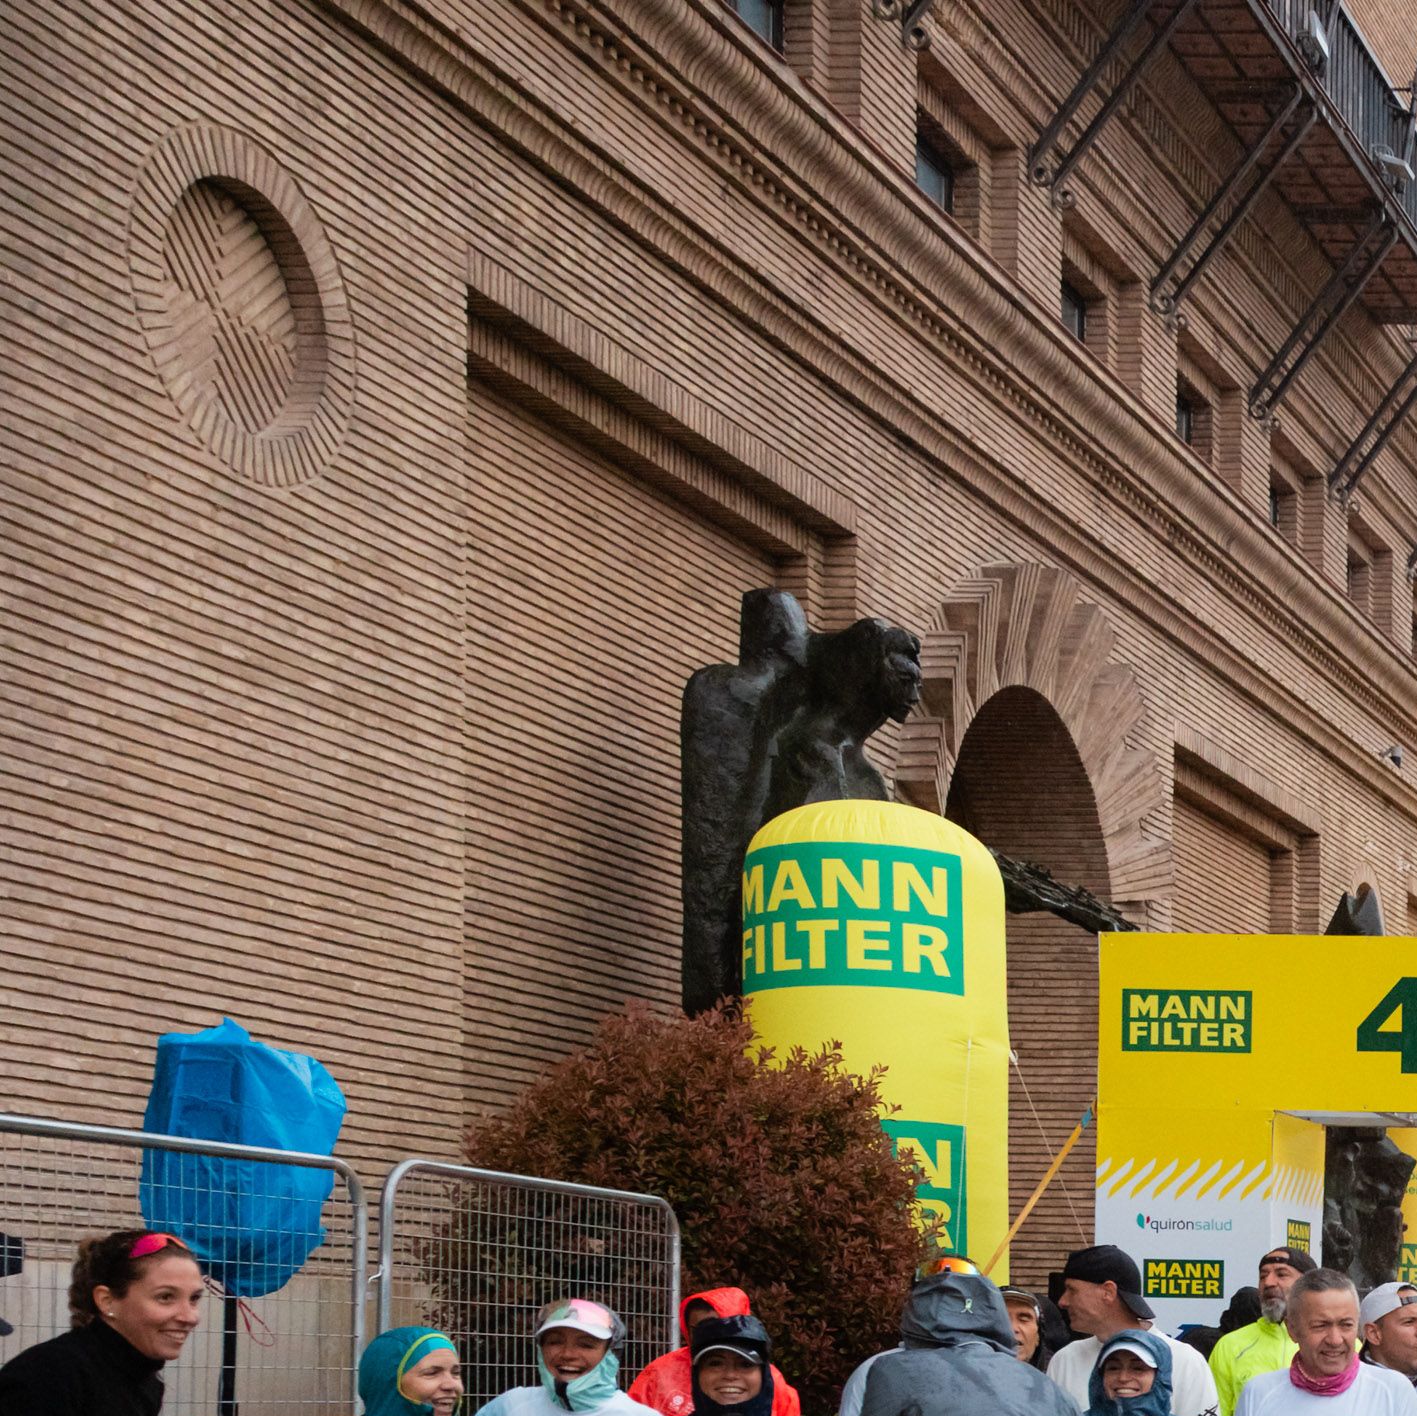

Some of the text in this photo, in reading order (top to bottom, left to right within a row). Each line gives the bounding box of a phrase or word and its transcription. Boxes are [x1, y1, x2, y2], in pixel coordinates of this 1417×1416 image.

[743, 859, 948, 918] MANN
[1129, 994, 1247, 1021] MANN
[1127, 1020, 1246, 1048] FILTER
[1150, 1212, 1233, 1233] quirónsalud
[1148, 1262, 1220, 1279] MANN
[1147, 1279, 1219, 1296] FILTER
